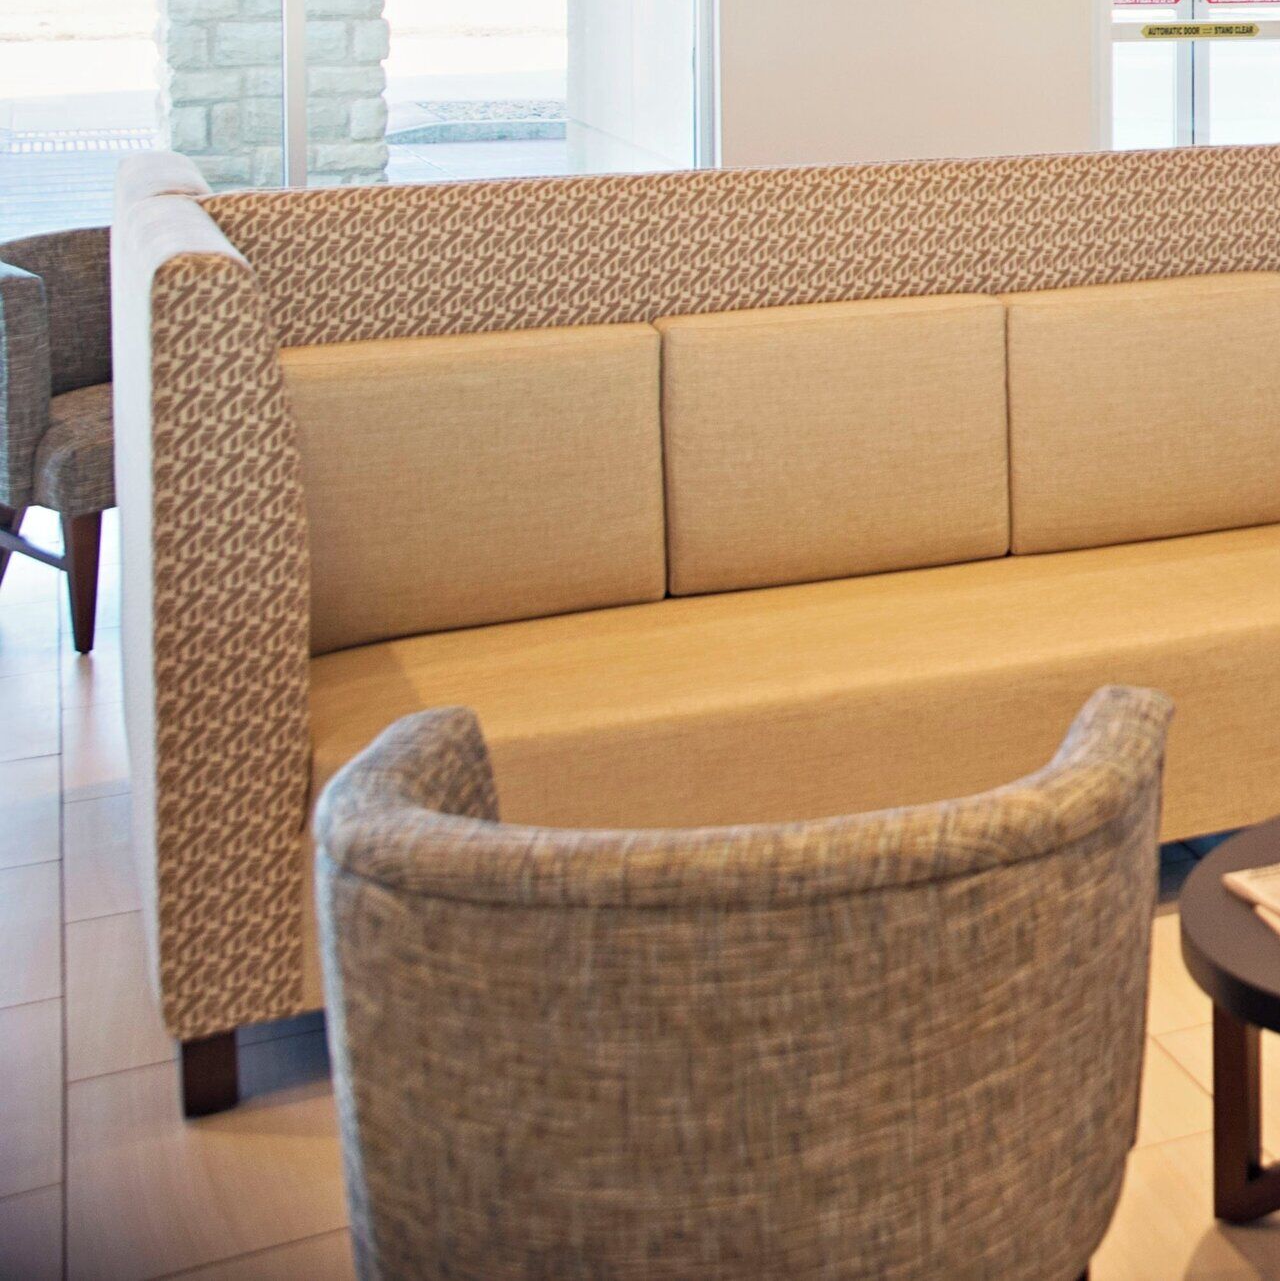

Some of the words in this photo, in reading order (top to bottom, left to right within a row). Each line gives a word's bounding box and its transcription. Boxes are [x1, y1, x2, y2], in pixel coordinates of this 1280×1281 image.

[1148, 27, 1183, 35] AUTOMATIC
[1184, 26, 1200, 35] DOOR
[1214, 26, 1233, 34] STAND
[1235, 25, 1254, 34] CLEAR
